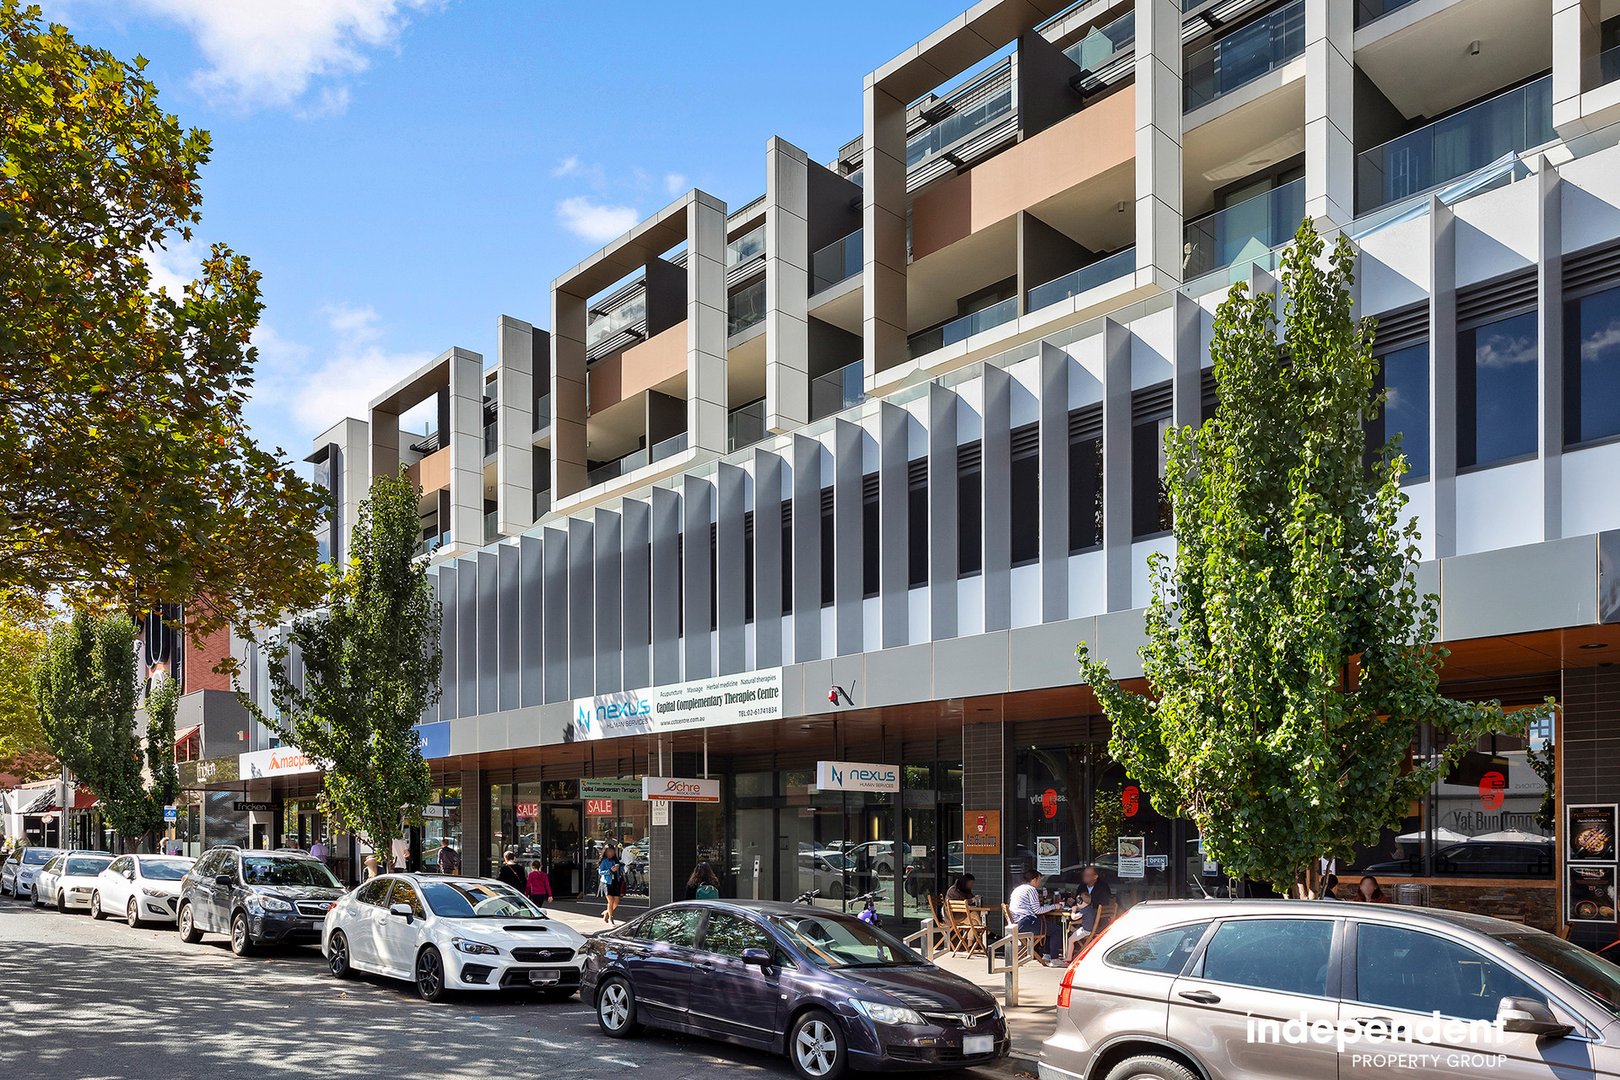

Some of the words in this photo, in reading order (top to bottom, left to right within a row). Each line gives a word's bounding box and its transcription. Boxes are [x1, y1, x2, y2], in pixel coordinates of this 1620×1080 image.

[659, 689, 683, 698] Acupuncture
[686, 686, 703, 694] Massage
[706, 681, 719, 691] Herbal
[719, 680, 738, 688] medicine
[740, 677, 756, 686] Natural
[756, 674, 777, 684] therapies
[656, 700, 676, 714] Capital
[676, 694, 723, 711] Complementary
[724, 689, 756, 705] Therapies
[757, 686, 779, 700] Centre
[596, 699, 651, 721] nexus
[606, 720, 625, 729] HUMAN
[625, 718, 649, 727] SERVICES
[850, 769, 896, 782] nexus
[516, 804, 539, 817] SALE
[588, 799, 612, 813] SALE
[1453, 811, 1473, 830] Yat
[1475, 811, 1499, 831] Bun
